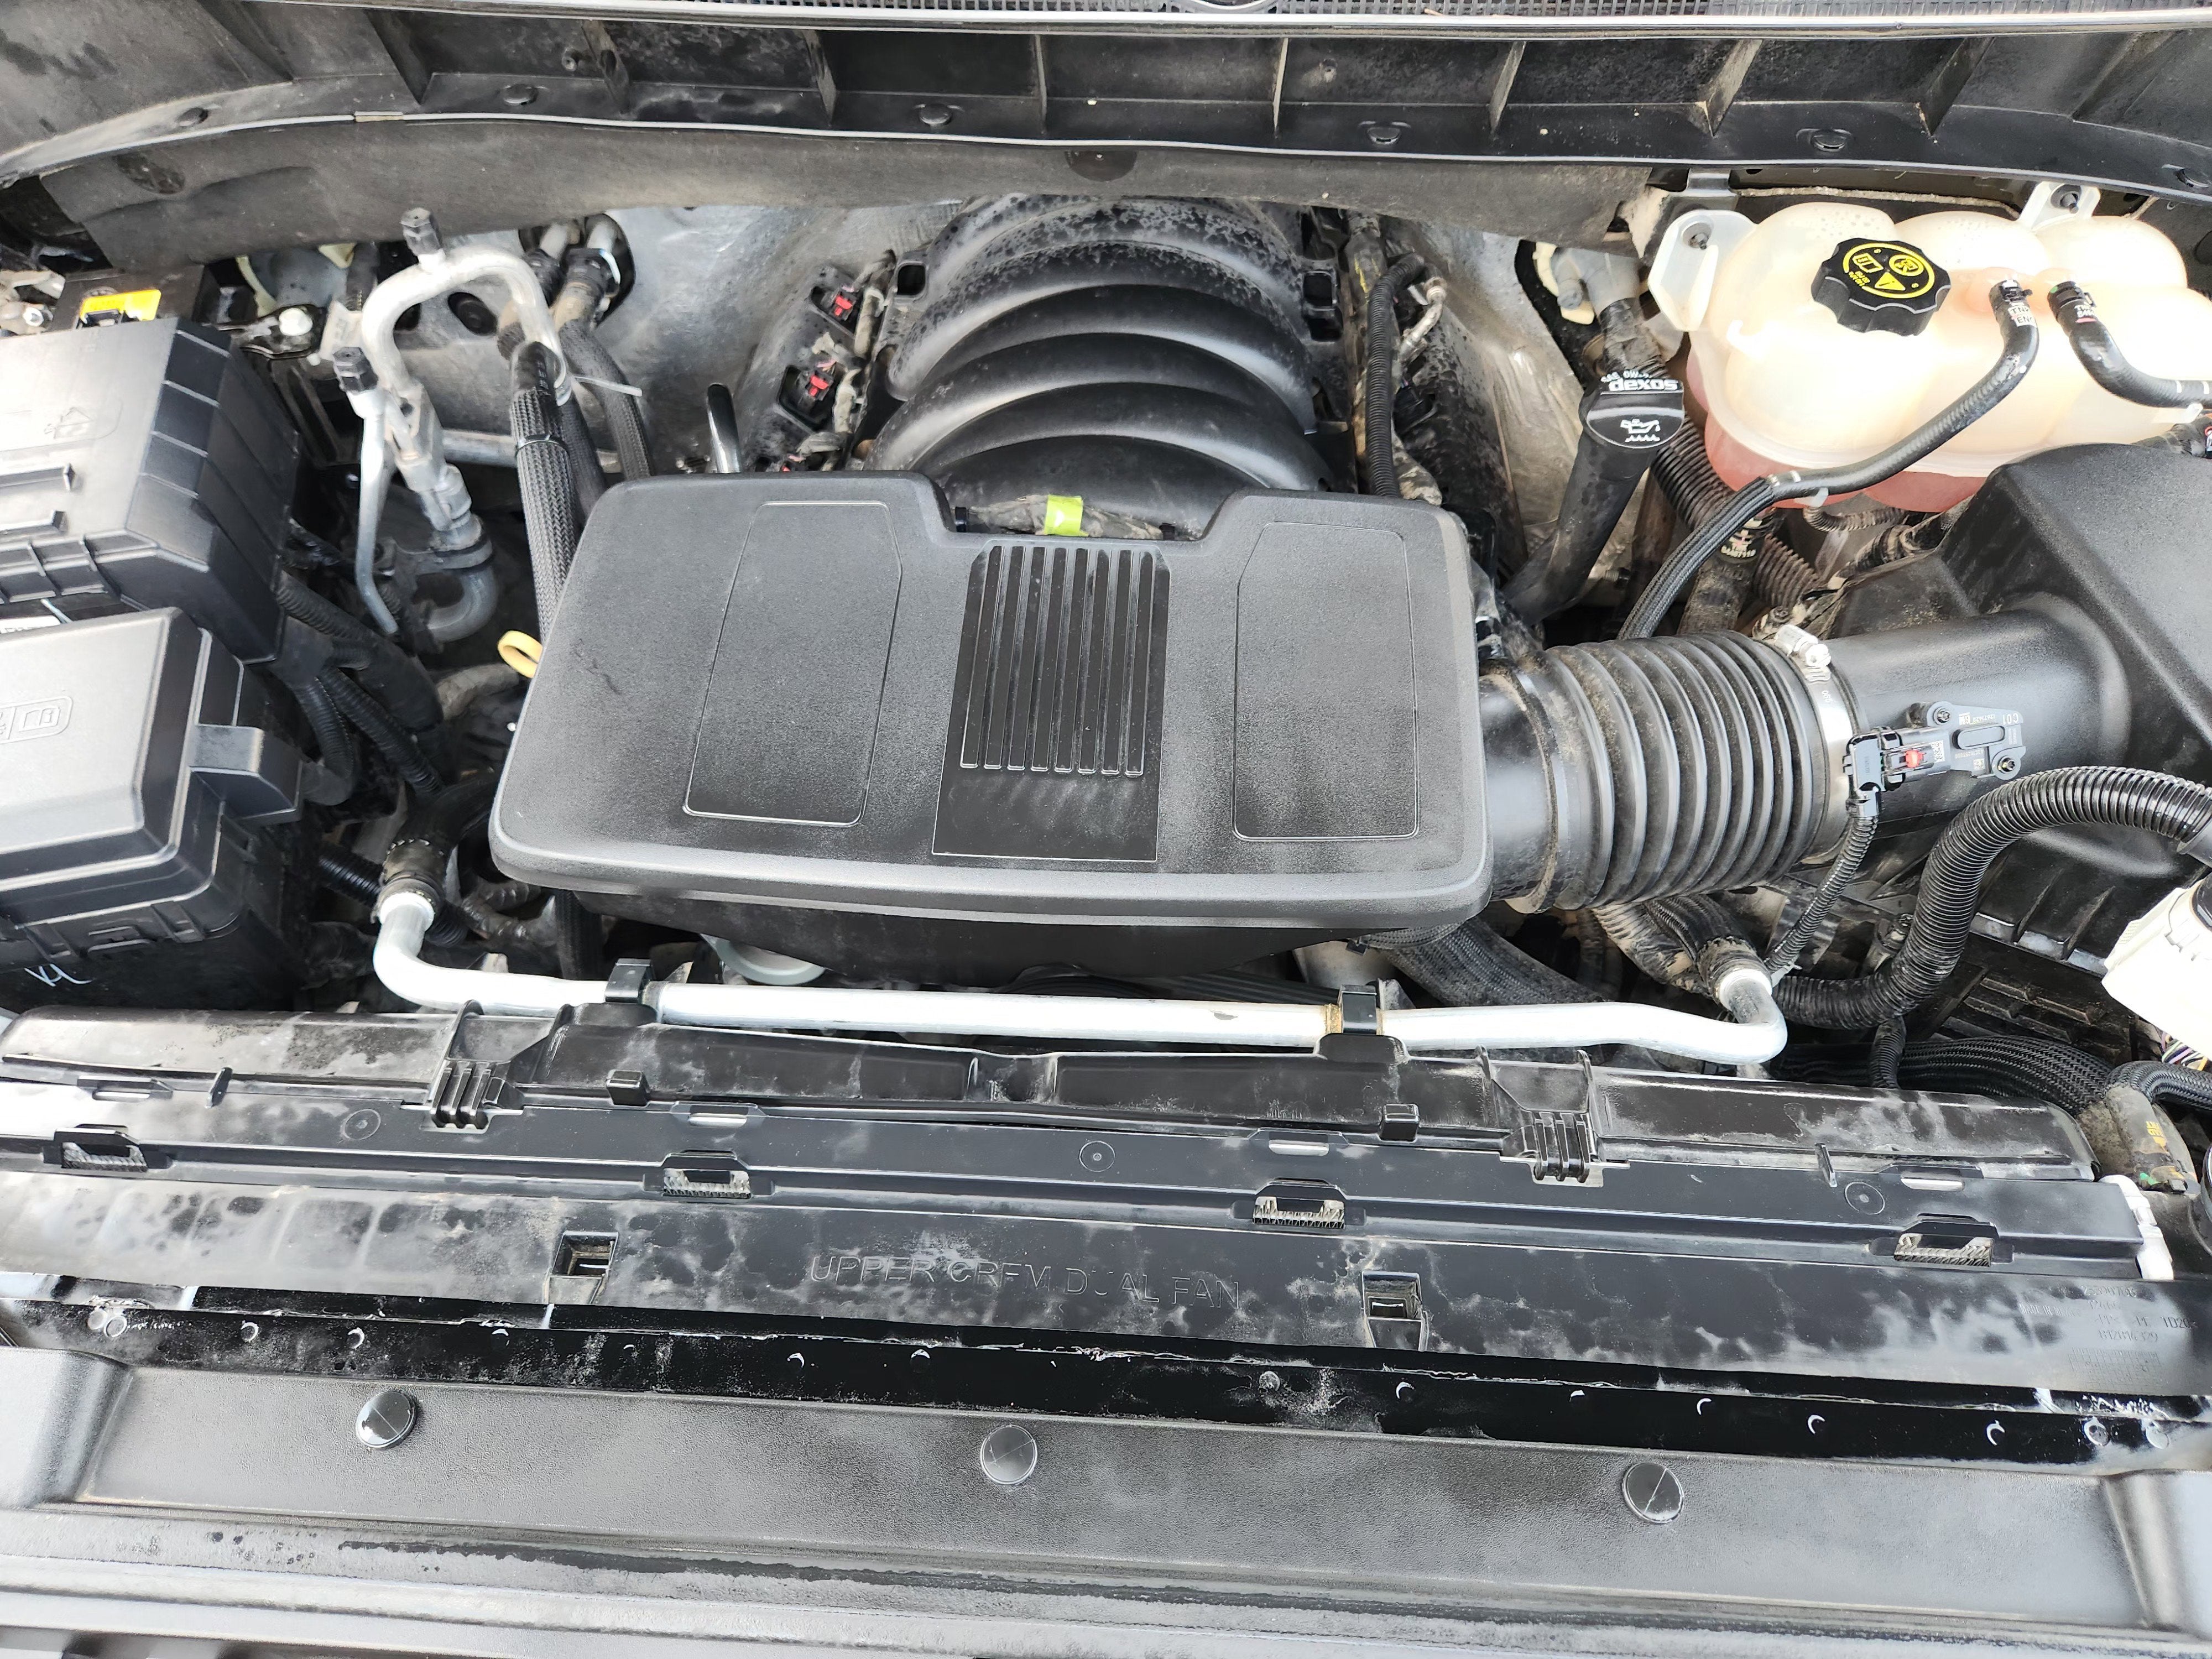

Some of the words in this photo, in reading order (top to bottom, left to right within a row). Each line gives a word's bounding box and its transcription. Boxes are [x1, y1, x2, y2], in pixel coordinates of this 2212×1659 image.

[1609, 377, 1678, 392] dexos
[1958, 713, 1971, 726] GM
[810, 1256, 936, 1282] UPPER
[1063, 1267, 1160, 1302] DUAL
[1171, 1276, 1239, 1310] FAN
